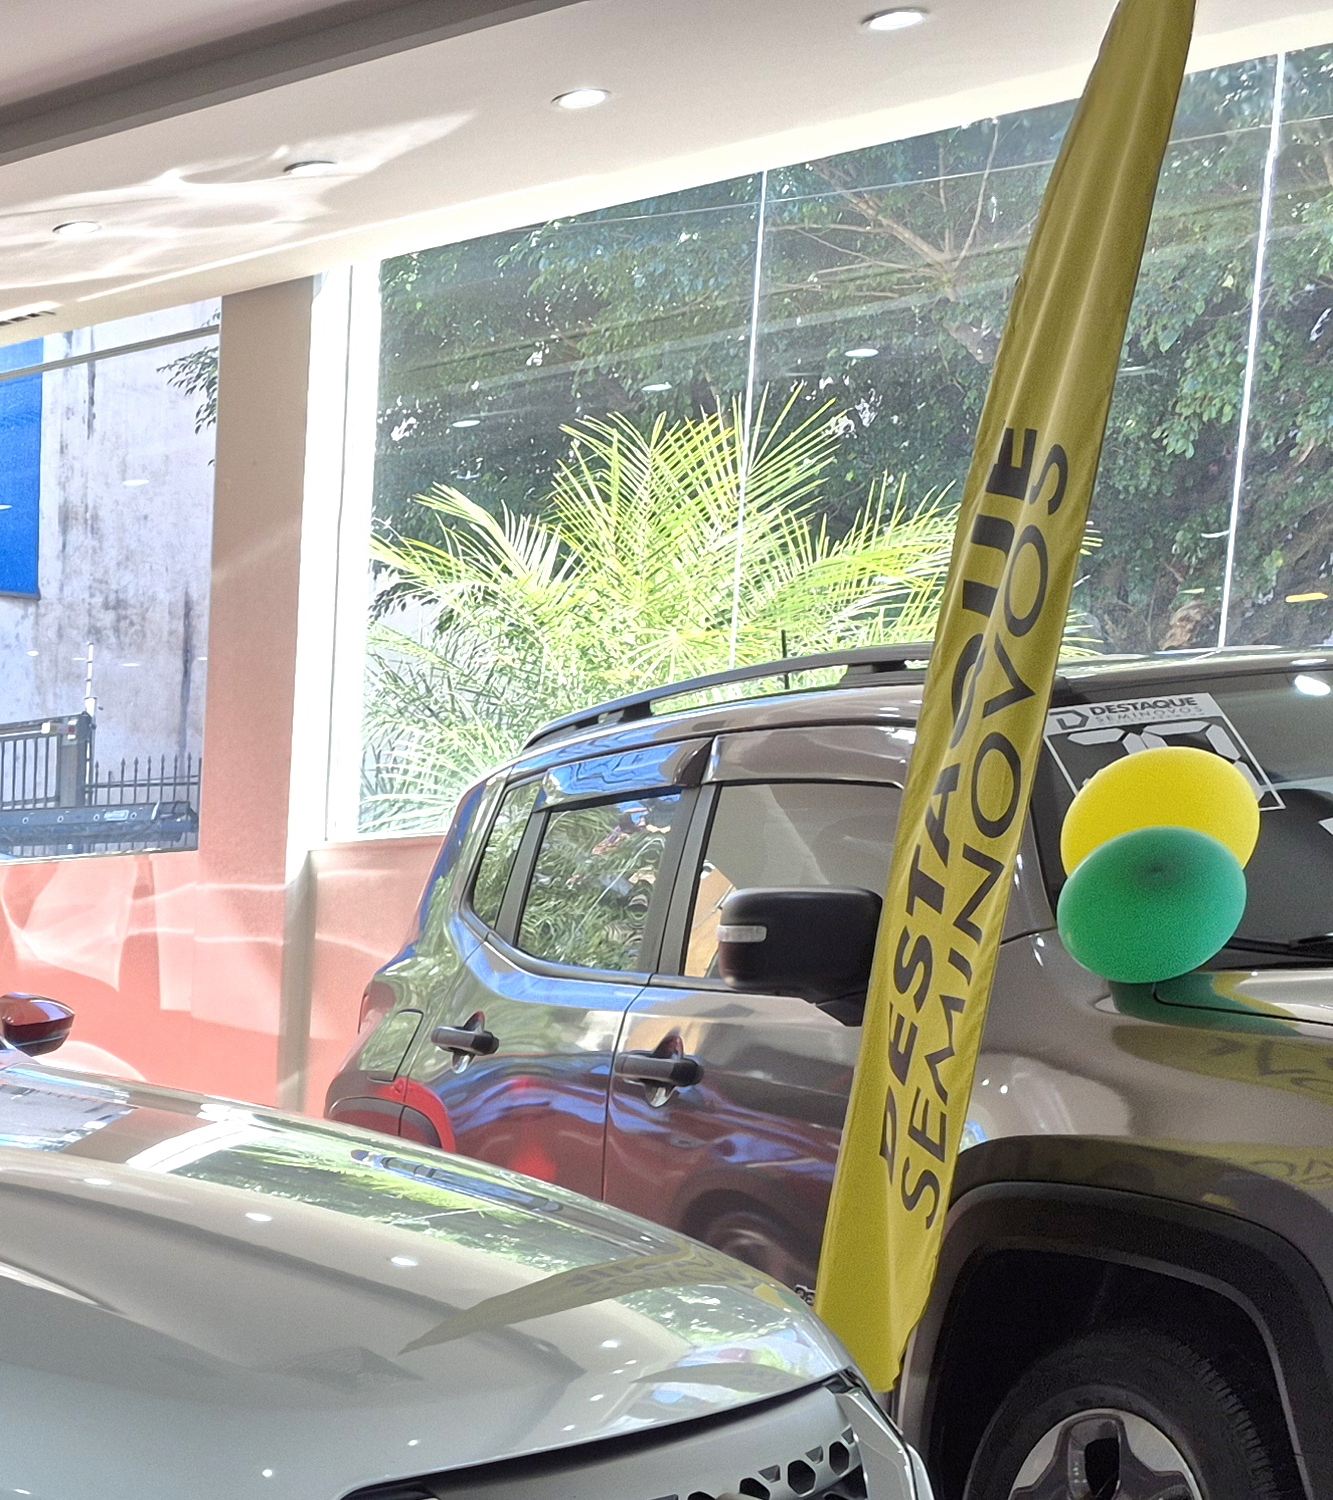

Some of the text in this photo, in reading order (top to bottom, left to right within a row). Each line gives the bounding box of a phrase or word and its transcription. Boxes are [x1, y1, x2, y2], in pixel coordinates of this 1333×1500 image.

[880, 422, 1038, 1185] DESTAQUE
[901, 443, 1068, 1230] SEMINOVOS
[1090, 697, 1198, 716] DESTAQUE
[1095, 705, 1203, 723] SEMINOVOS
